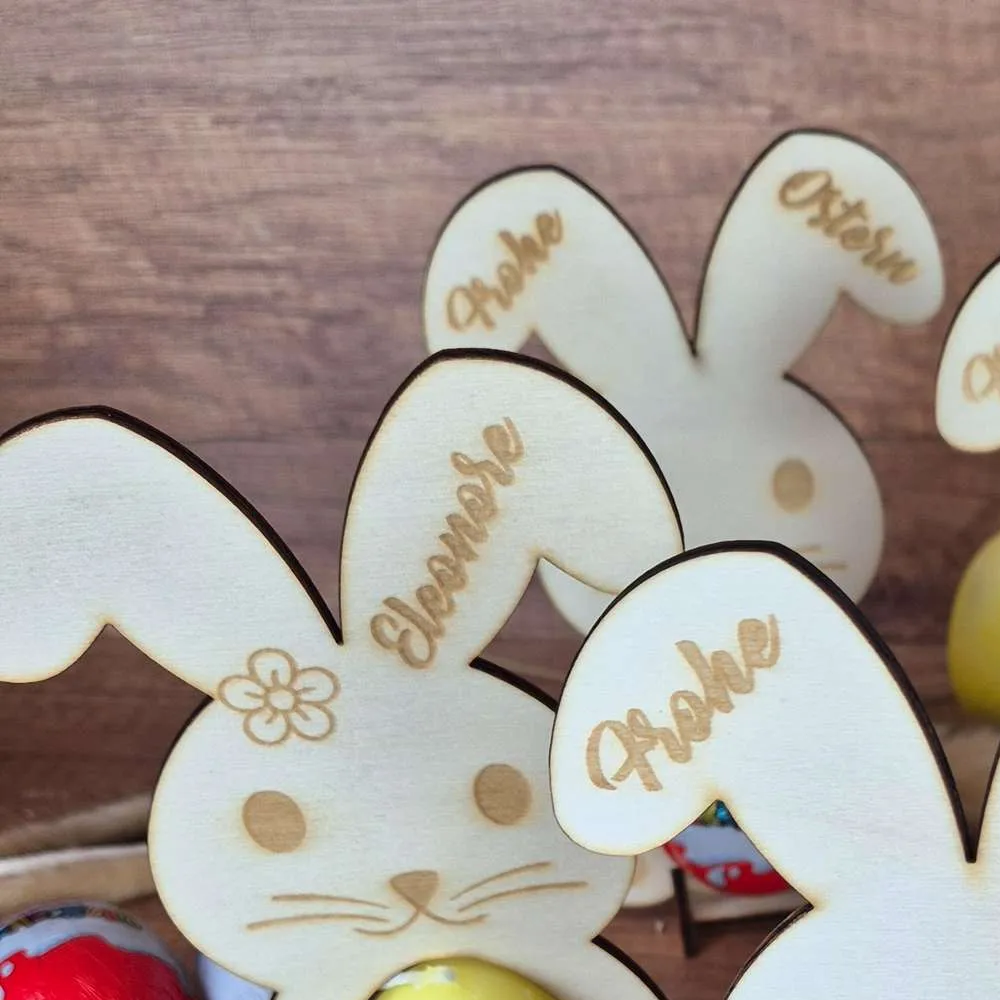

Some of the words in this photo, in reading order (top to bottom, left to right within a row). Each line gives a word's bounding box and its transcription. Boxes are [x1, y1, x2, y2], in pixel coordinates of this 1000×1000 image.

[447, 209, 563, 332] Frohe
[777, 169, 921, 286] Ostern
[370, 416, 524, 669] Eleonore
[585, 613, 780, 791] Frohe
